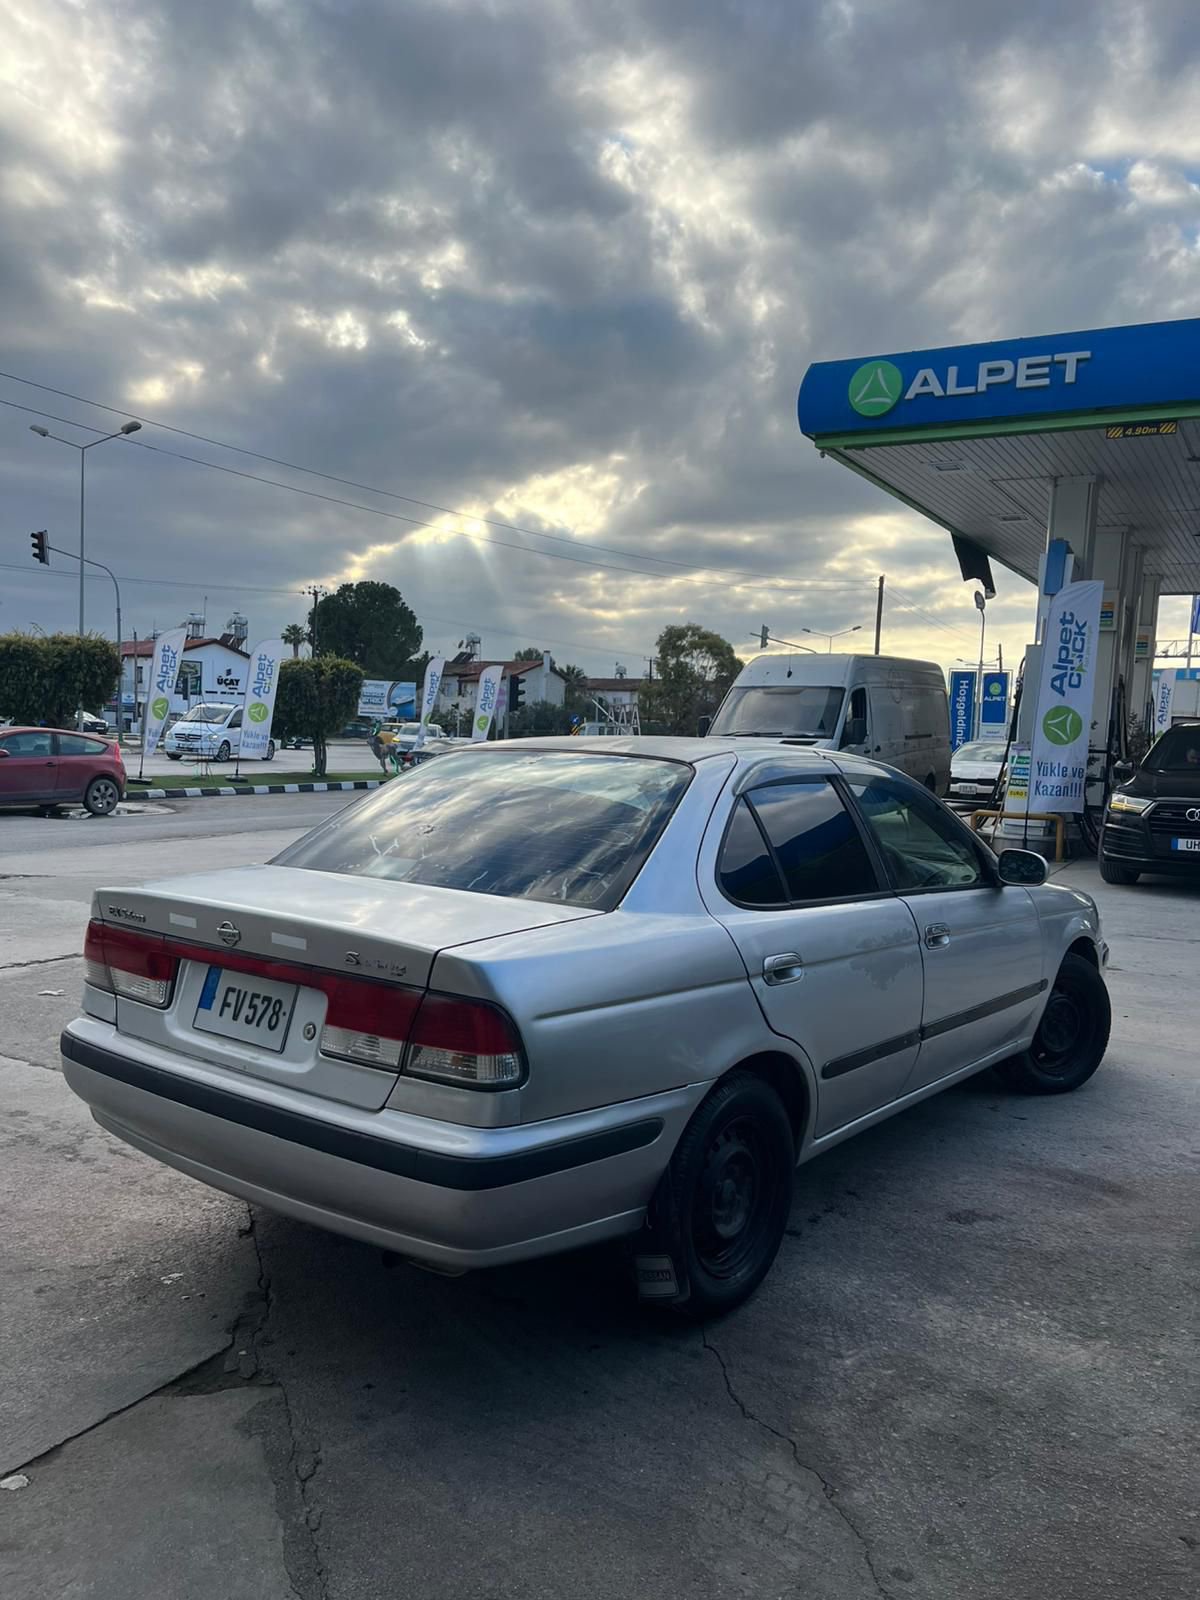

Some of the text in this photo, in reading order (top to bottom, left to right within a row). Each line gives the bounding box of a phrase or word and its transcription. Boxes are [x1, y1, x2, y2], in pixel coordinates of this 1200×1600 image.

[904, 351, 1092, 400] ALPET
[1125, 425, 1158, 437] 4.90m
[157, 644, 171, 693] Alpet
[1050, 611, 1075, 697] Alpet
[252, 653, 267, 698] Alpet
[480, 677, 493, 712] Alpet
[1034, 779, 1082, 799] Kazan!!!
[1037, 761, 1084, 779] Yükle ve
